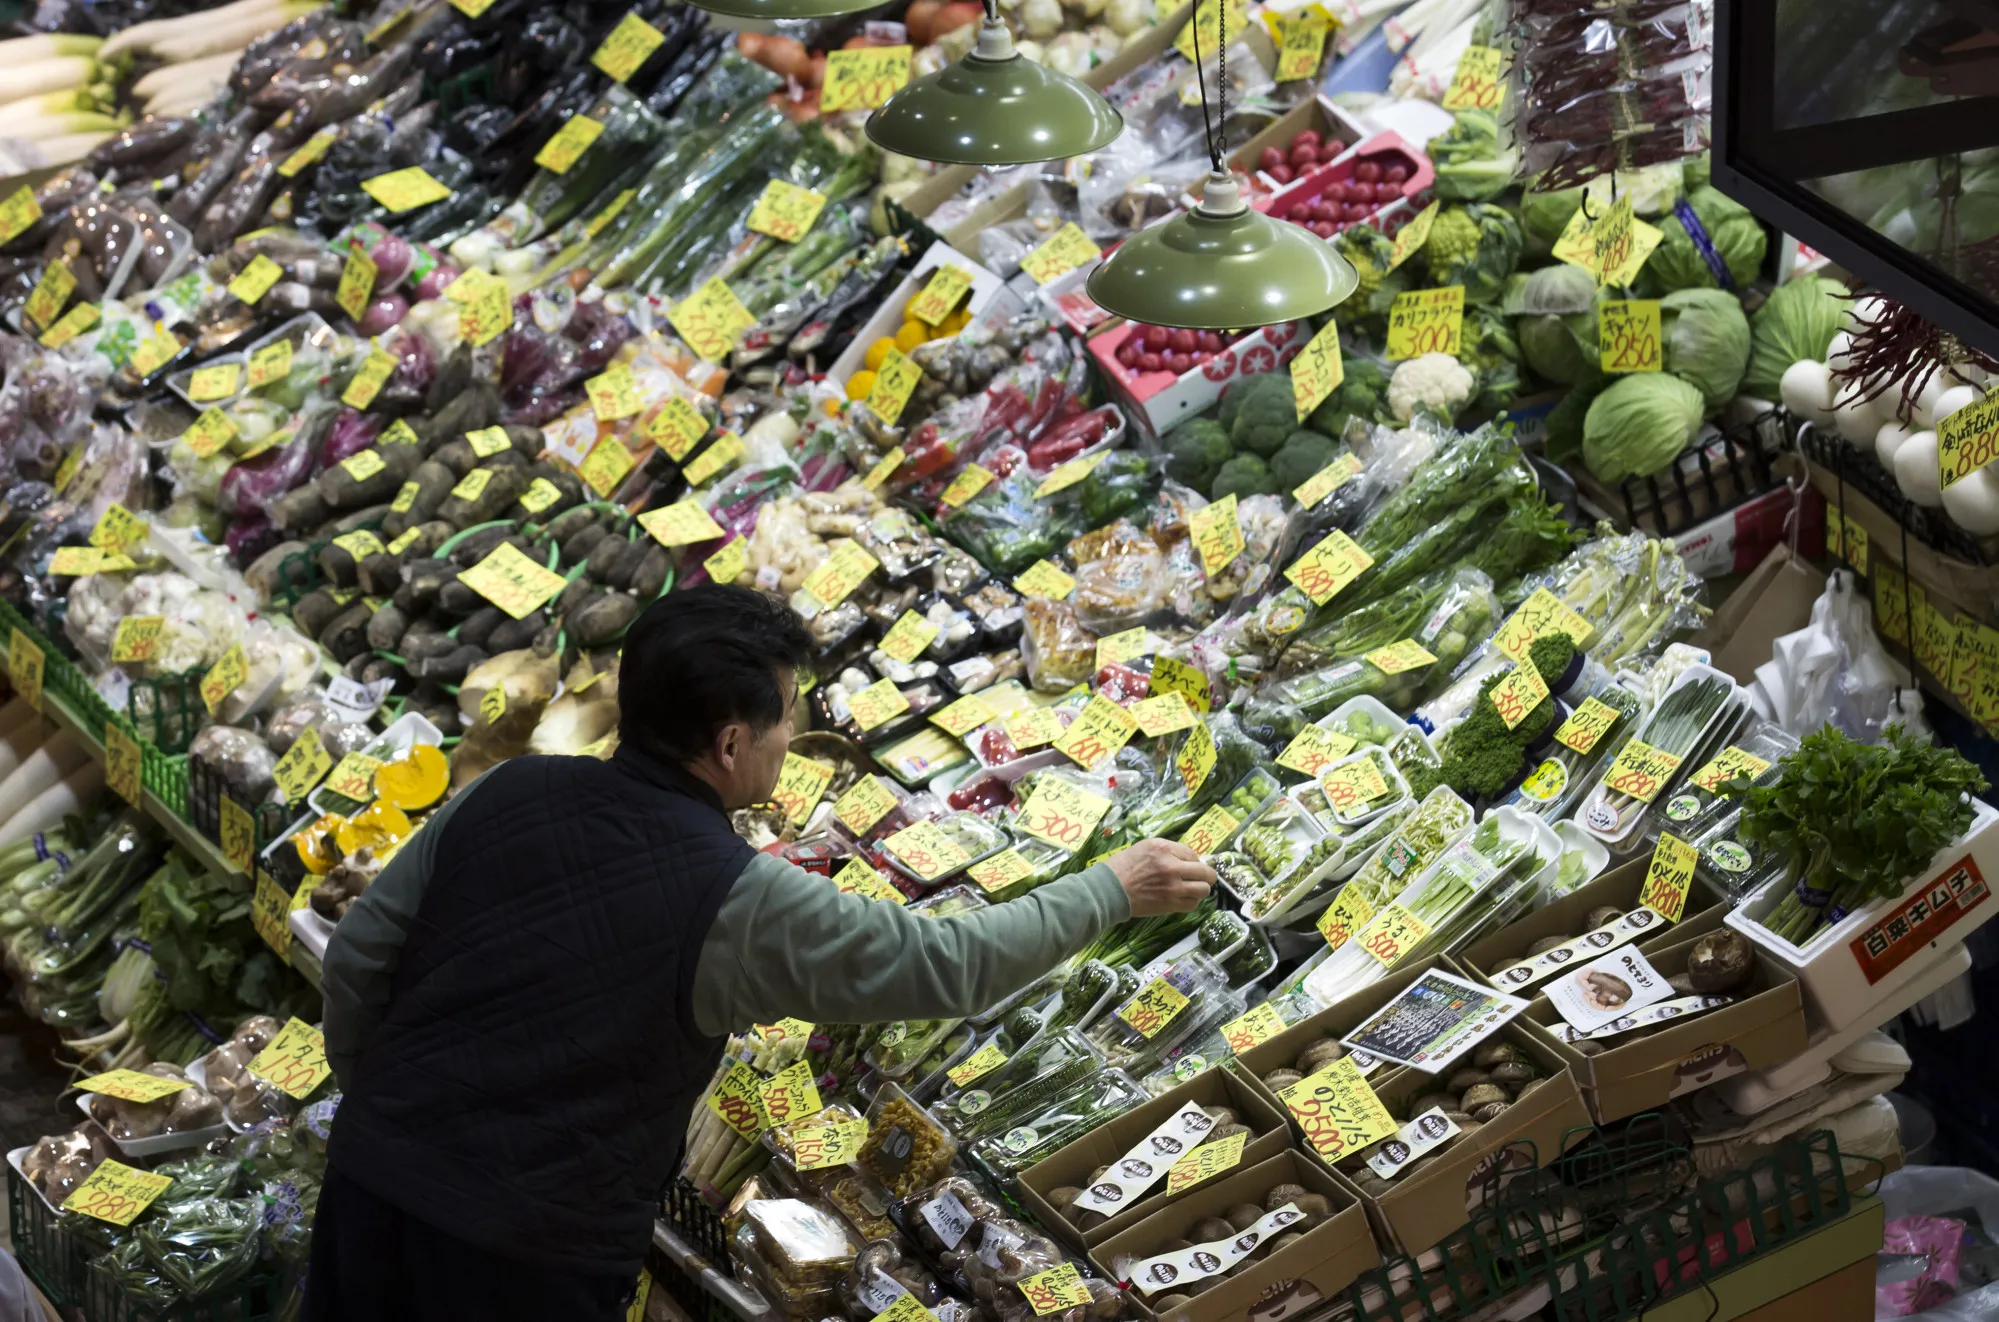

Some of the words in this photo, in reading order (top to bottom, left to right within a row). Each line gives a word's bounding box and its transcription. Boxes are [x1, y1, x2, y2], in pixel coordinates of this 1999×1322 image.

[839, 78, 897, 110] 200
[1393, 307, 1463, 329] カリフラワー
[1509, 669, 1541, 710] なの花
[1571, 709, 1611, 740] のびる
[1651, 861, 1689, 890] のと115
[1866, 868, 1969, 957] 白菜キムチ
[1381, 917, 1416, 944] うるい
[1620, 955, 1654, 989] のとてまり
[1137, 988, 1178, 1018] あさつき
[275, 1035, 332, 1072] レタス
[1313, 1085, 1372, 1147] のと115
[820, 1128, 844, 1165] なめこ
[1197, 1148, 1217, 1180] のと115
[1041, 1276, 1074, 1307] のと115
